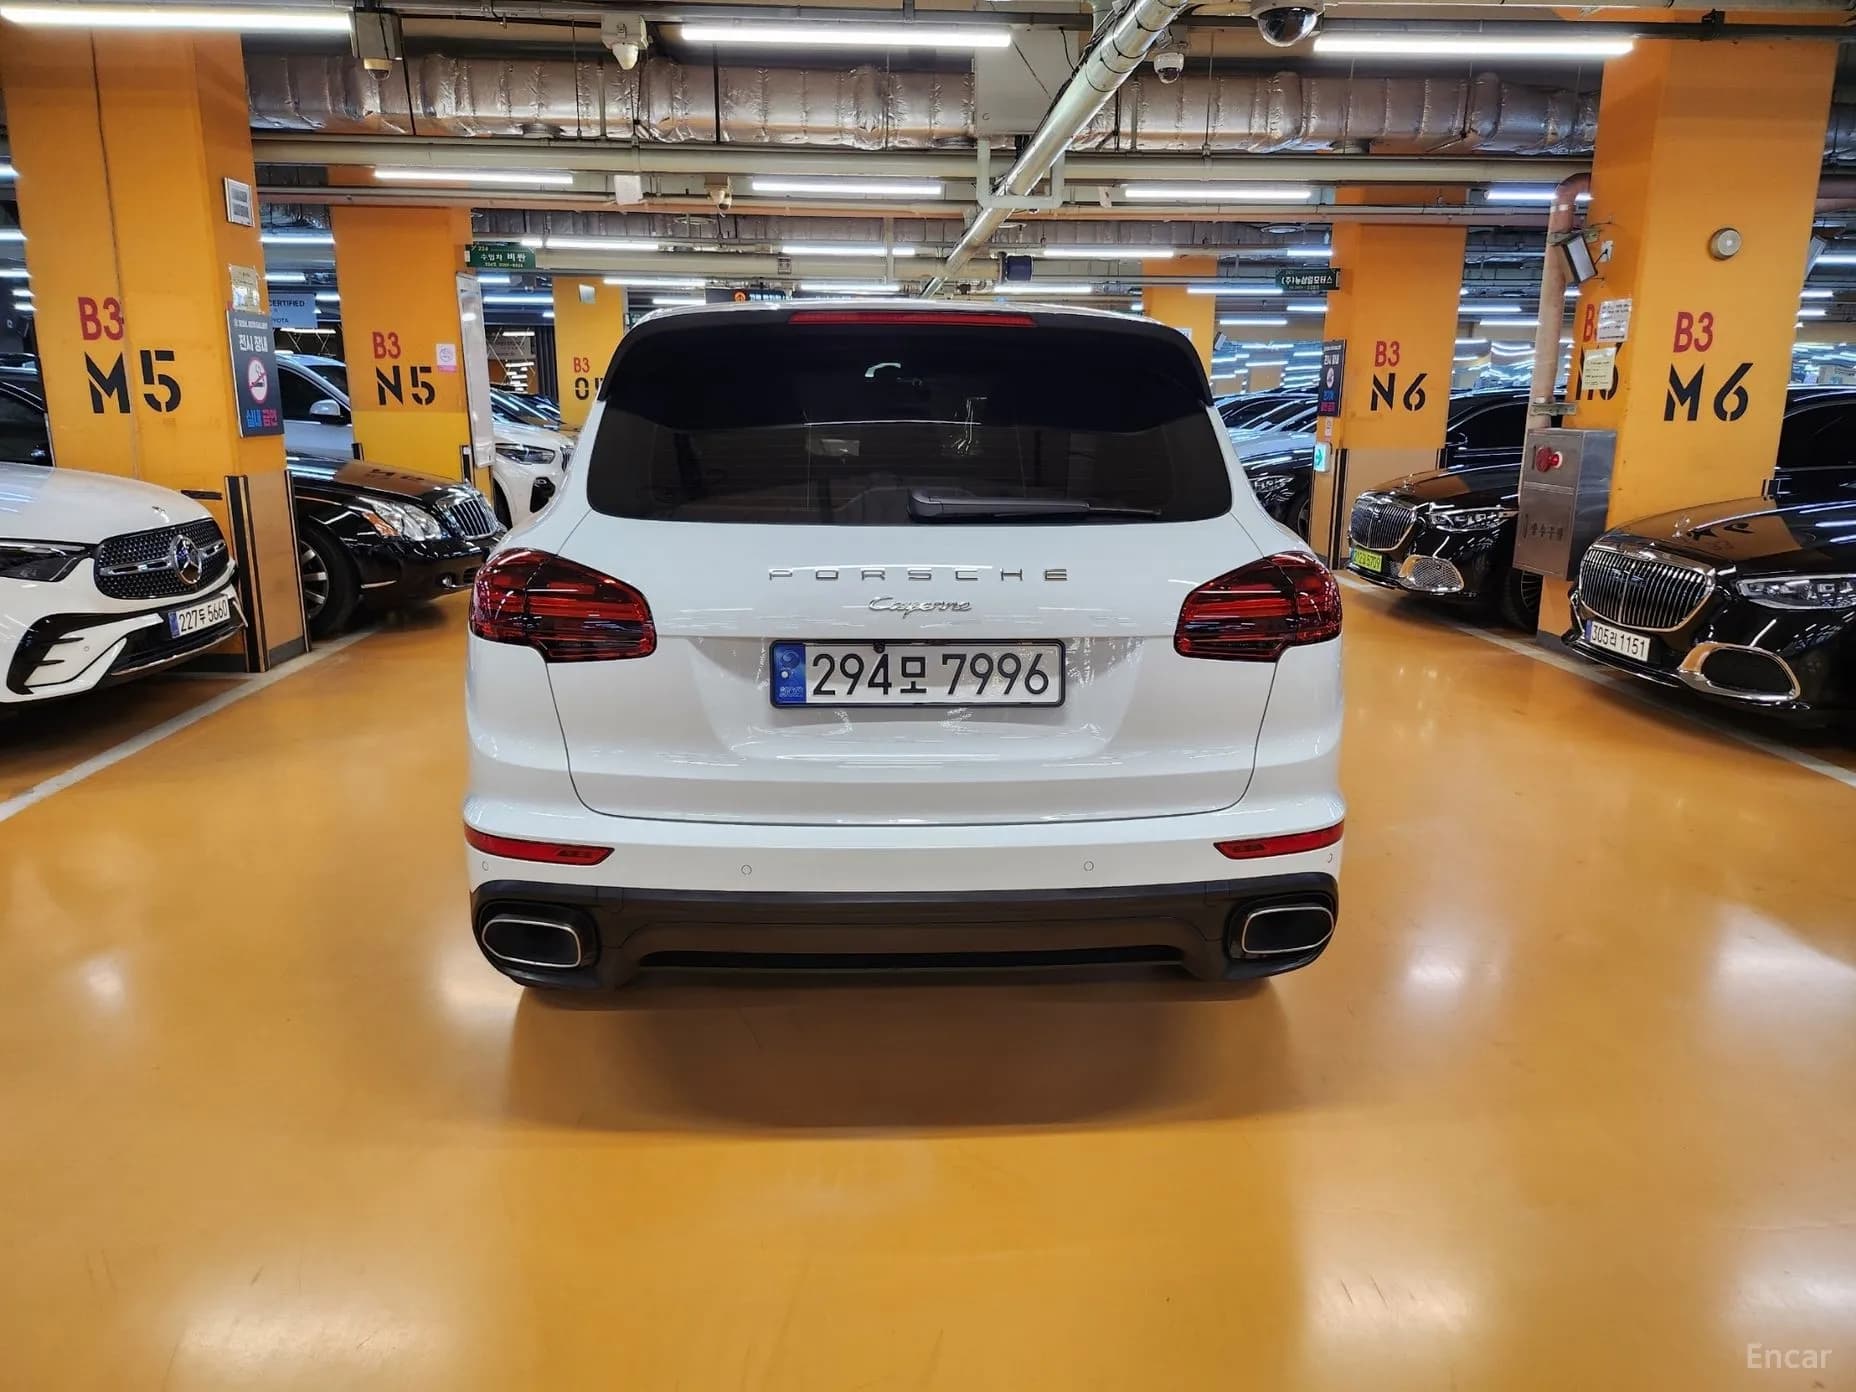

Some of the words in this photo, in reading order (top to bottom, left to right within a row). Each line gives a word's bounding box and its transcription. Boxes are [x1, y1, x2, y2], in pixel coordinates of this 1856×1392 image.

[78, 297, 124, 340] B3
[1583, 303, 1598, 342] B
[1673, 312, 1714, 352] B3
[372, 331, 401, 359] B3
[1375, 341, 1400, 367] B3
[84, 350, 181, 414] M5
[573, 357, 590, 373] B3
[375, 365, 435, 405] N5
[1370, 372, 1428, 412] N6
[1664, 362, 1754, 421] M6
[769, 568, 1067, 581] PORSCHE
[868, 597, 973, 619] Cayenne
[1620, 633, 1646, 658] 1151
[812, 653, 927, 696] 294모
[942, 653, 1050, 696] 7996
